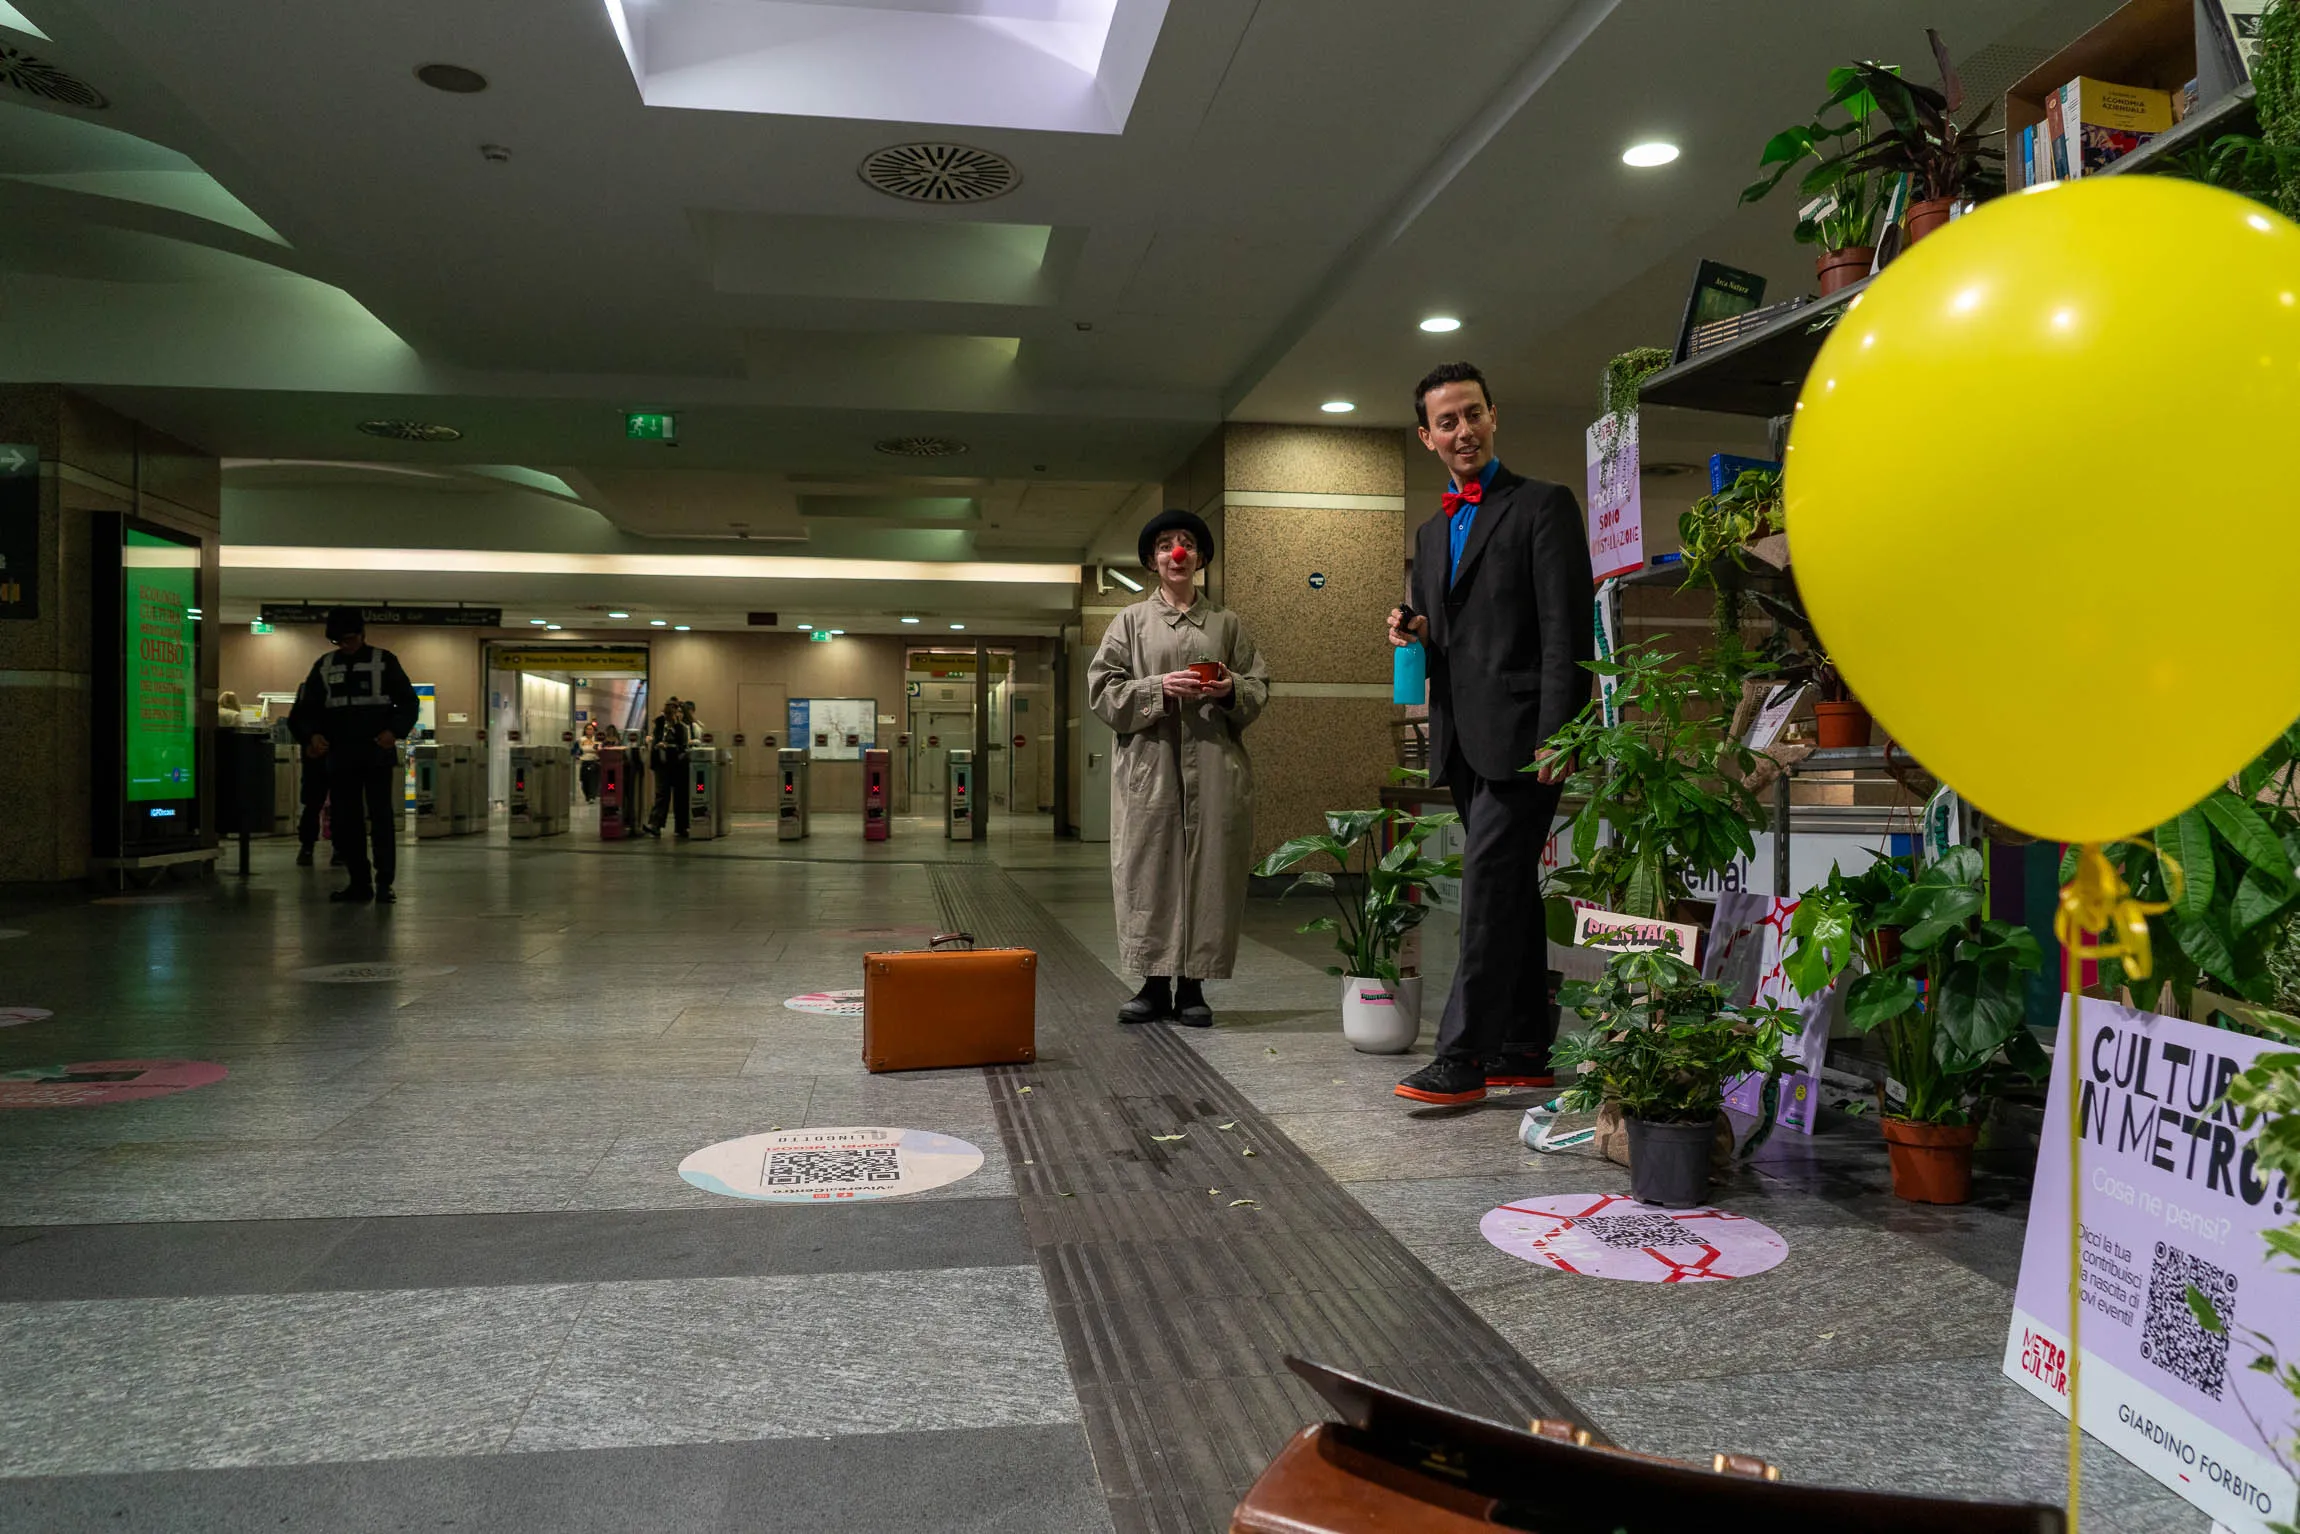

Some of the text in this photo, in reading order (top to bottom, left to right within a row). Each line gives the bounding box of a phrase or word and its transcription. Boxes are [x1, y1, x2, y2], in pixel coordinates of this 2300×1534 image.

[2102, 96, 2145, 108] ECONOMIA
[2102, 103, 2147, 115] AZIENDALE
[1599, 508, 1620, 530] SONO
[361, 607, 400, 622] Uscita
[2092, 1025, 2268, 1128] CULTUR
[778, 1134, 866, 1143] LINGOTTO
[2092, 1167, 2231, 1246] Cosa ne pensi?
[2078, 1223, 2132, 1263] Dicci la tua
[2082, 1250, 2143, 1289] contribuisci
[2089, 1273, 2127, 1302] nascita
[2128, 1293, 2140, 1309] di
[2097, 1299, 2134, 1328] eventi!
[2023, 1327, 2065, 1371] METRO
[2118, 1404, 2272, 1515] GIARDINO FORBITO
